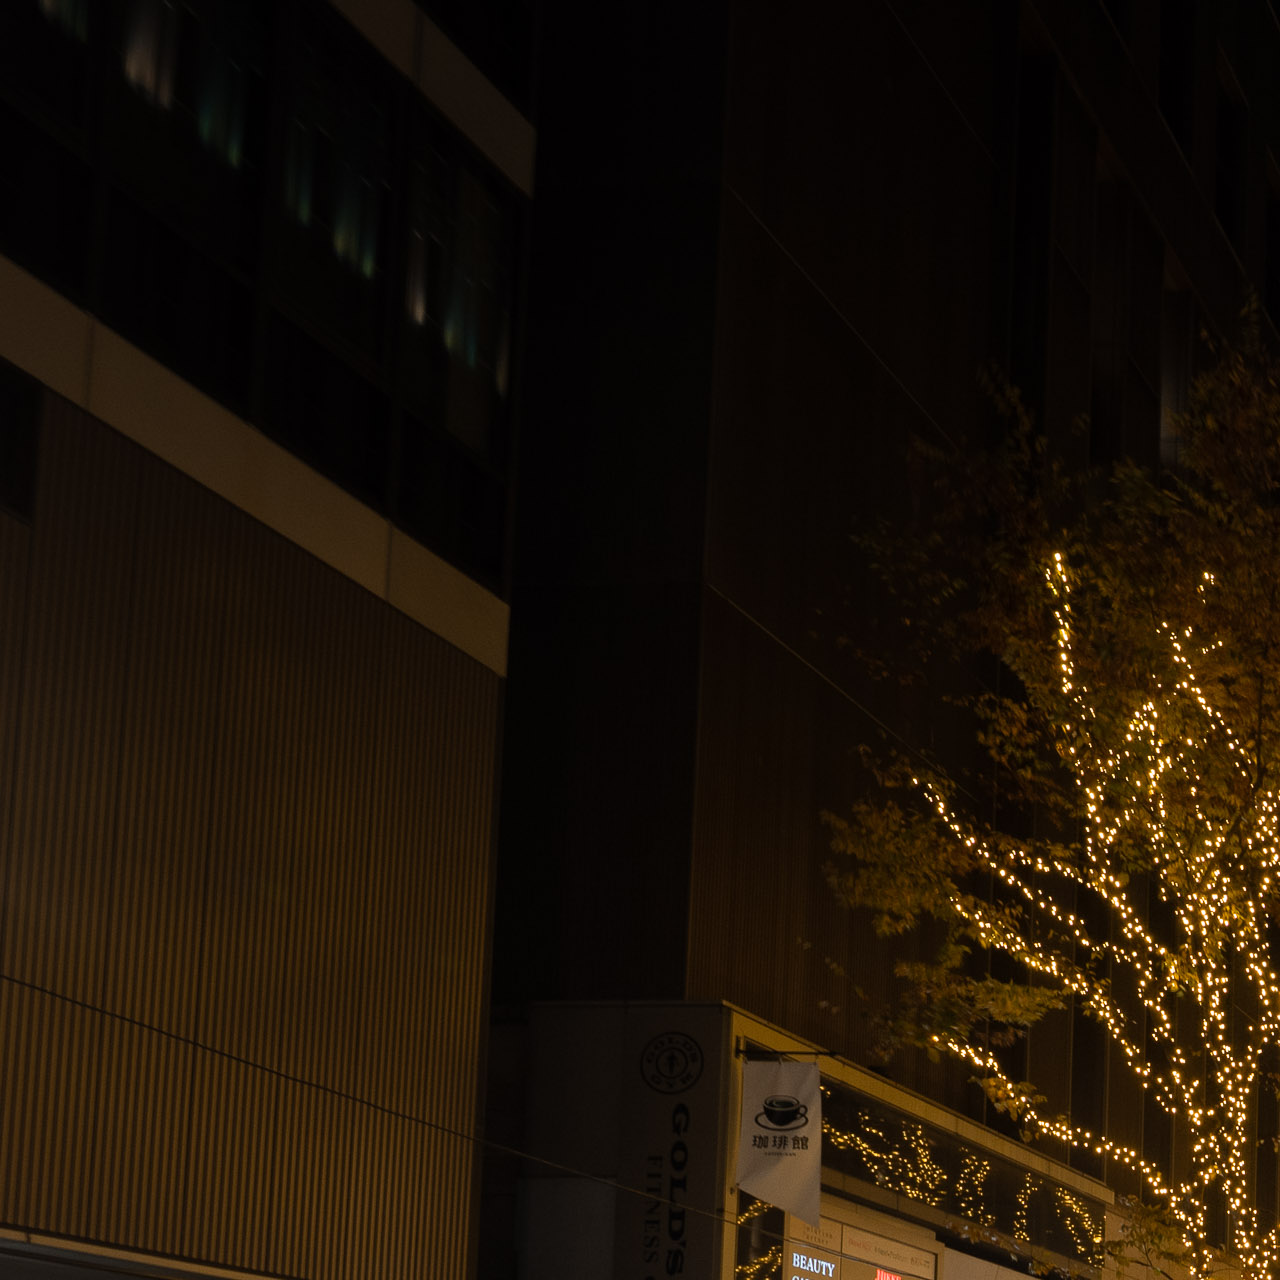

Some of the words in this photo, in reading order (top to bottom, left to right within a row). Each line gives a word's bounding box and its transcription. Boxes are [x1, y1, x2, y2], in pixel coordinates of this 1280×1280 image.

[752, 1134, 809, 1151] 珈琲館
[641, 1155, 664, 1267] FITNESS
[664, 1102, 690, 1279] GOLD'S
[792, 1252, 836, 1278] BEAUTY
